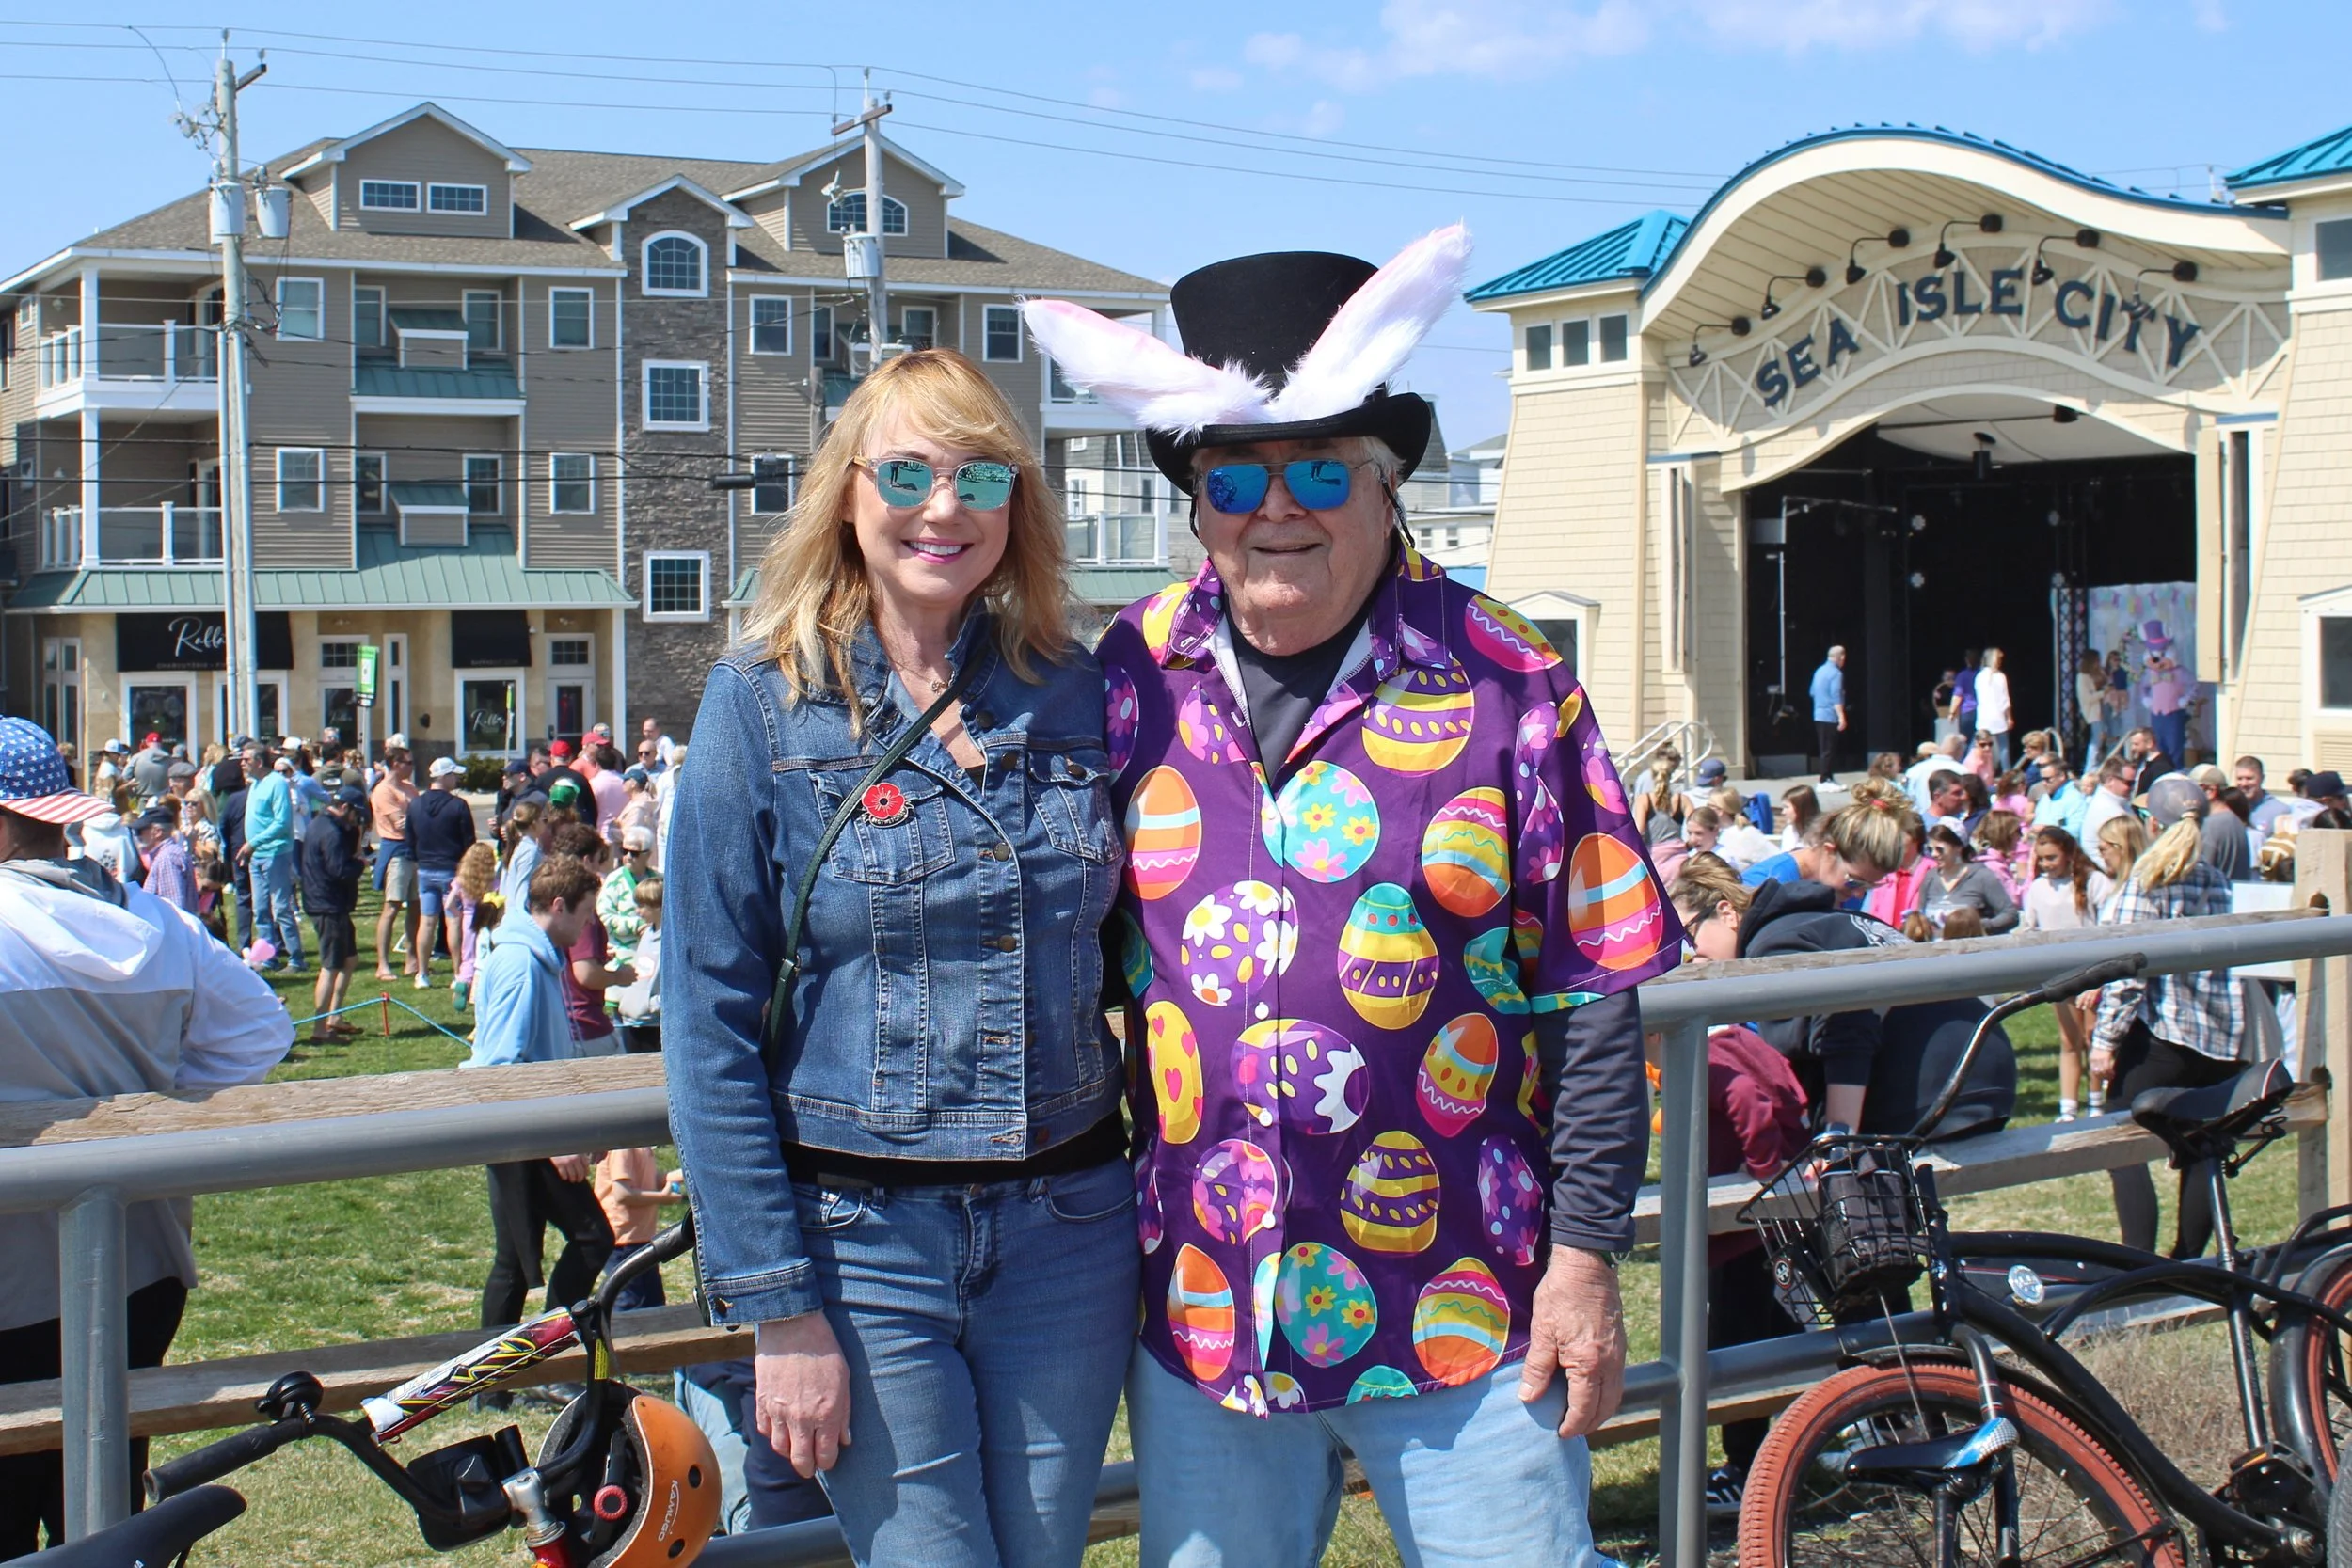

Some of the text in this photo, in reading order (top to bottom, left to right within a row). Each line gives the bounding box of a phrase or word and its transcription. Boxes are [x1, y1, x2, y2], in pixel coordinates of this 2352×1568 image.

[1755, 270, 2201, 408] SEA ISLE CITY
[658, 1479, 679, 1542] KAMUGO
